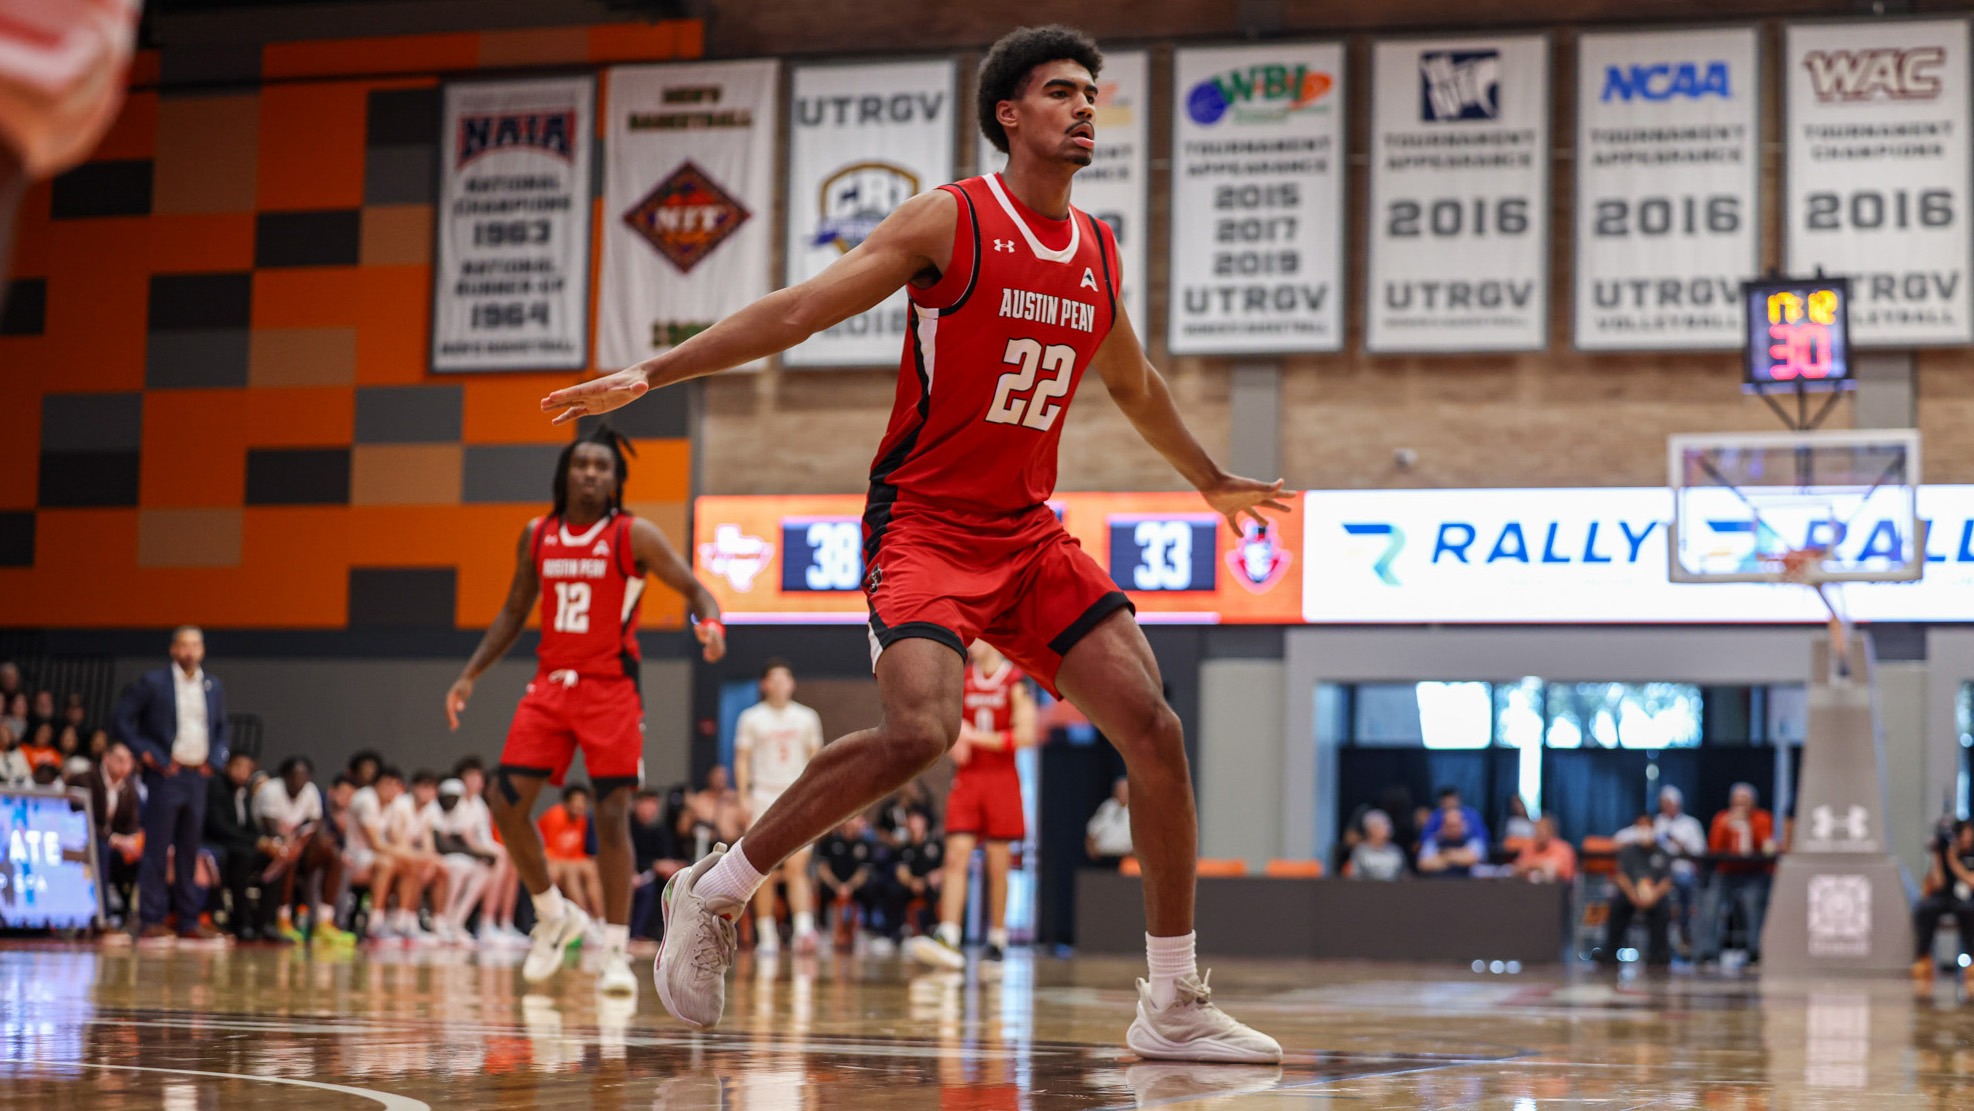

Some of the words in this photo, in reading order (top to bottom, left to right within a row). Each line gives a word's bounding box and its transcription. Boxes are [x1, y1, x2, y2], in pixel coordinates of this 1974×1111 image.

[1601, 61, 1732, 101] NCAA
[1803, 46, 1946, 100] WAC
[797, 92, 944, 127] UTRGV
[461, 111, 573, 163] NAIA
[1384, 130, 1534, 148] TOURNAMENT
[1590, 124, 1745, 143] TOURNAMENT
[1804, 121, 1954, 139] TOURNAMENT
[1185, 136, 1329, 155] TOURNAMENT
[1591, 147, 1742, 166] APPEARANCE
[1186, 158, 1327, 177] APPEARANCE
[1385, 152, 1531, 170] APPEARANCE
[1214, 184, 1300, 210] 2015
[1807, 190, 1954, 230] 2016
[1215, 217, 1298, 243] 2017
[1387, 198, 1530, 237] 2016
[1594, 196, 1741, 237] 2016
[474, 221, 551, 246] 1963
[1214, 250, 1300, 276] 2019
[1184, 284, 1327, 314] UTRGV
[1385, 280, 1533, 309] UTRGV
[1847, 271, 1961, 301] TRGV
[471, 302, 549, 330] 1964
[999, 288, 1059, 325] AUSTIN
[1060, 298, 1095, 333] PEAY
[1769, 323, 1831, 380] 30
[985, 337, 1076, 431] 22
[806, 522, 862, 589] 38
[1134, 521, 1192, 589] 33
[1431, 521, 1658, 563] RALLY
[554, 582, 591, 633] 12
